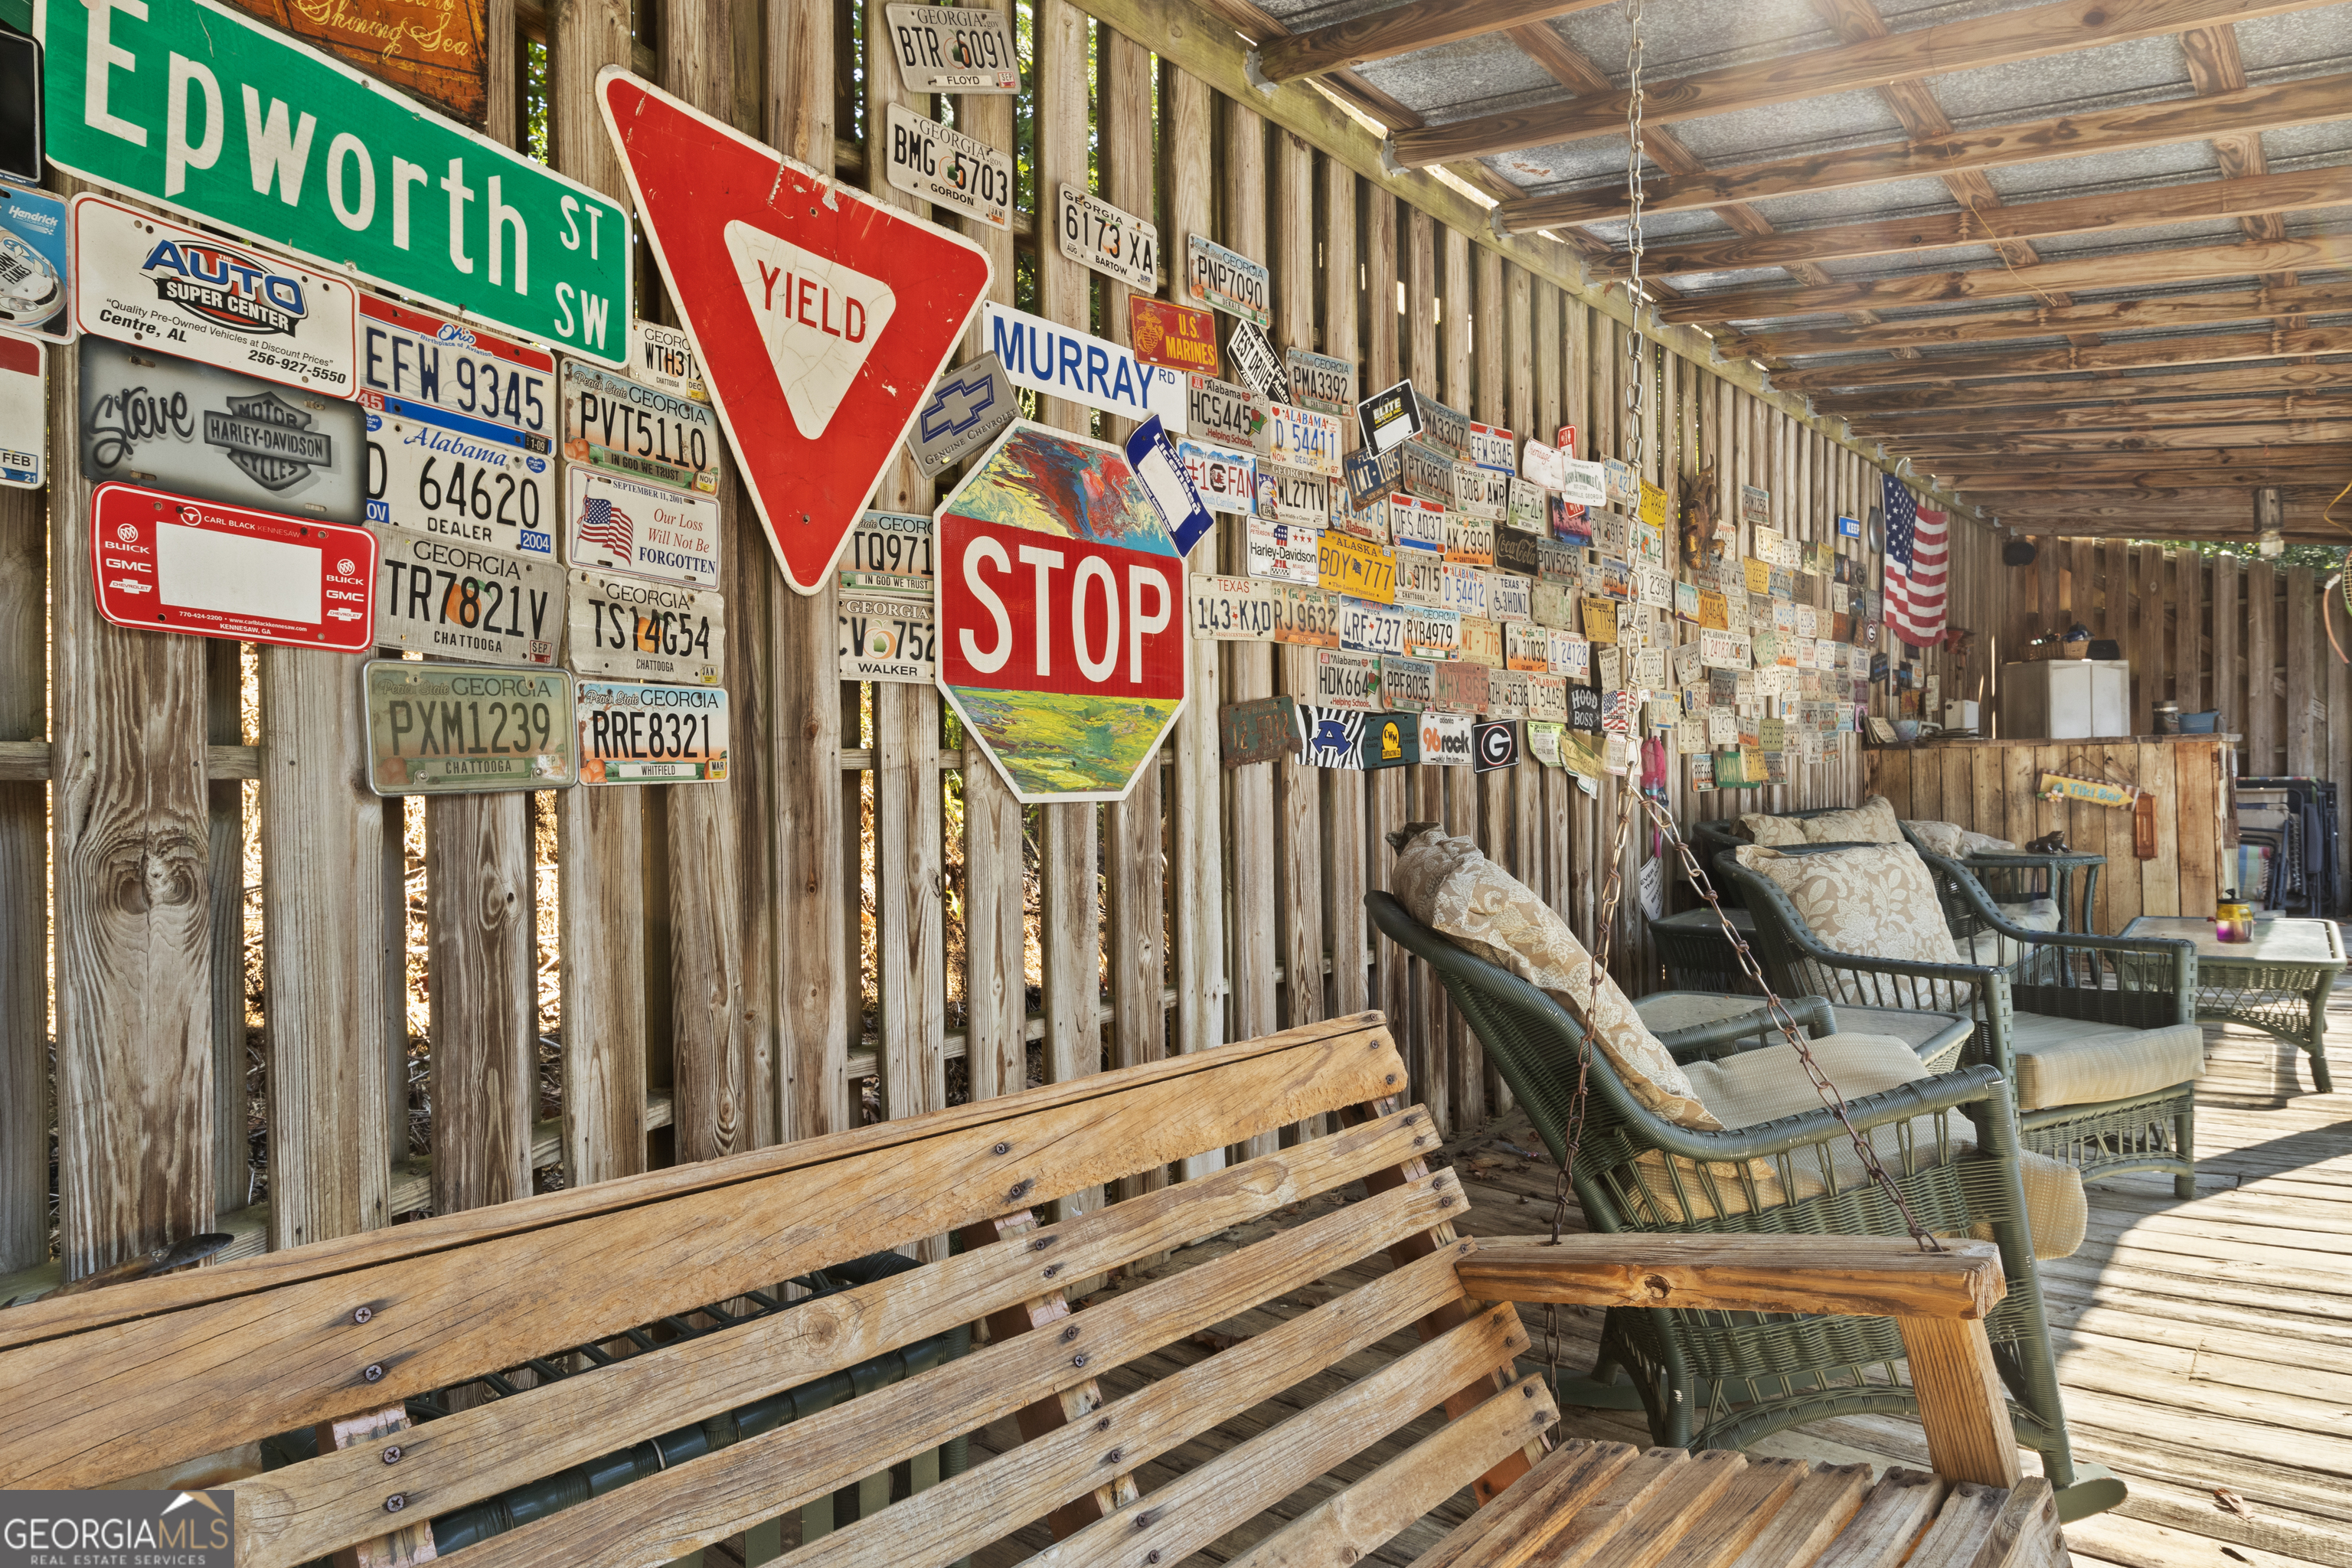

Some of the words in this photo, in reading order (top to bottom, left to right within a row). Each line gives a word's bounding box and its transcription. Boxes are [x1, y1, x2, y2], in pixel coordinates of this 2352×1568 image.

[291, 0, 403, 60] Shining
[401, 12, 469, 57] Sea
[897, 26, 943, 67] BTR
[956, 30, 1009, 68] 6091
[947, 77, 980, 86] FLOYD
[84, 0, 528, 296] Epworth
[894, 124, 936, 177] BMG
[955, 152, 1008, 207] 5703
[930, 183, 974, 206] GORDON
[8, 205, 59, 226] Hendrick
[1063, 191, 1123, 225] GEORGIA
[560, 195, 603, 260] ST
[1066, 204, 1120, 259] 6173
[1129, 232, 1153, 275] XA
[2, 264, 32, 285] FLAKES
[142, 240, 305, 315] AUTO
[1095, 255, 1128, 276] BARTOW
[1223, 253, 1264, 281] GEORGIA
[1197, 256, 1263, 310] PNP7090
[166, 281, 223, 308] SUPER
[227, 296, 289, 332] CENTER
[757, 259, 866, 344] YIELD
[100, 309, 160, 338] Centre,
[167, 328, 187, 342] AL
[554, 282, 609, 350] SW
[1178, 313, 1200, 338] U.S.
[151, 310, 207, 333] Pre-Owned
[210, 326, 247, 344] Vehicles
[261, 341, 300, 359] Discount
[436, 324, 476, 345] Ohio
[993, 315, 1155, 410] MURRAY
[1158, 368, 1175, 385] RD
[1165, 335, 1215, 366] MARINES
[1233, 323, 1255, 363] TEST
[1248, 350, 1272, 394] DRIVE
[1256, 336, 1276, 366] South
[1274, 365, 1288, 385] End
[247, 349, 346, 384] 256-927-5550
[366, 326, 440, 403] EFW
[457, 358, 544, 431] 9345
[1314, 358, 1349, 375] GEORGIA
[1206, 380, 1241, 400] Alabama
[1272, 380, 1289, 402] Auto
[1294, 366, 1348, 403] PMA3392
[238, 399, 298, 427] MOTOR
[629, 385, 707, 426] GEORGIA
[1191, 389, 1251, 436] HCS445
[1310, 400, 1333, 412] CHATTOOGA
[1373, 397, 1401, 420] ELITE
[1434, 405, 1467, 426] GEORGIA
[580, 391, 707, 472] PVT5110
[1284, 408, 1328, 430] ALABAMA
[211, 418, 323, 459] HARLEY-DAVIDSON
[403, 426, 508, 468] Alabama
[924, 438, 965, 466] GENUINE
[967, 407, 1017, 442] CHEVROLET
[1207, 428, 1230, 444] Helping
[1231, 433, 1253, 448] Schools
[1293, 423, 1334, 461] 54411
[2, 452, 31, 467] FEB
[1491, 440, 1513, 467] 9345
[1528, 443, 1552, 466] Heritage
[612, 453, 619, 467] IN
[622, 456, 639, 472] GOD
[641, 460, 653, 475] WE
[655, 463, 679, 482] TRUST
[1153, 432, 1201, 516] Licensed
[1272, 464, 1312, 481] GEORGIA
[1408, 456, 1452, 495] PTK8501
[419, 456, 540, 529] 64620
[613, 480, 657, 498] SEPTEMBER
[1228, 463, 1256, 500] FAN
[1277, 476, 1325, 512] WL27TV
[1457, 475, 1479, 501] 1308
[204, 515, 227, 525] CARL
[229, 520, 256, 530] BLACK
[257, 525, 301, 538] KENNESAW
[427, 517, 492, 543] DEALER
[653, 508, 675, 526] Our
[678, 514, 704, 533] Loss
[1345, 520, 1373, 537] Alabama
[1394, 508, 1414, 535] DFS
[1417, 513, 1442, 541] 4037
[1847, 521, 1860, 535] KEEP
[104, 541, 150, 554] BUICK
[522, 533, 550, 552] 2004
[648, 527, 671, 546] Will
[673, 531, 693, 550] Not
[695, 536, 710, 554] Be
[1250, 541, 1317, 564] Harley-Davidson
[1336, 537, 1378, 557] ALASKA
[1448, 528, 1459, 553] AK
[1463, 531, 1491, 555] 2990
[1496, 533, 1537, 567] Coca-Cola
[106, 558, 152, 573] GMC
[413, 540, 522, 581] GEORGIA
[639, 547, 717, 576] FORGOTTEN
[1319, 547, 1351, 579] BDY
[1364, 559, 1393, 593] 777
[1538, 550, 1578, 576] PQV5253
[326, 574, 364, 586] BUICK
[1217, 579, 1250, 593] TEXAS
[1414, 565, 1440, 592] 9715
[1451, 567, 1478, 581] ALABAMA
[1501, 578, 1520, 590] TEXAS
[326, 590, 364, 602] GMC
[384, 559, 548, 641] TR7821V
[606, 583, 691, 610] GEORGIA
[1354, 586, 1375, 597] Frontier
[1456, 579, 1485, 607] 54412
[1502, 592, 1527, 615] 3HDNZ
[179, 610, 223, 622] 770-424-2200
[845, 600, 930, 619] GEORGIA
[959, 535, 1171, 684] STOP
[1198, 598, 1231, 630] 143
[1240, 600, 1272, 632] KXD
[1274, 599, 1293, 631] RJ
[1298, 603, 1338, 636] 9632
[1361, 600, 1383, 611] TEXAS
[1364, 608, 1381, 616] TRUCK
[1423, 609, 1457, 622] GEORGIA
[260, 627, 272, 635] GA
[588, 599, 710, 659] TS14G54
[1344, 611, 1369, 642] 4RF
[1375, 617, 1400, 647] Z37
[1406, 619, 1453, 648] RYB4979
[1465, 619, 1491, 629] FLORIDA
[434, 631, 502, 654] CHATTOOGA
[1523, 639, 1547, 663] 31032
[1562, 642, 1587, 666] 24128
[636, 658, 674, 672] CHATTOOGA
[858, 663, 918, 676] WALKER
[1332, 655, 1361, 667] Alabama
[1403, 662, 1431, 675] GEORGIA
[451, 678, 552, 697] GEORGIA
[1319, 665, 1369, 697] HDK664
[1387, 671, 1430, 702] PPF8035
[640, 688, 719, 709] GEORGIA
[1332, 697, 1351, 707] Helping
[1352, 698, 1370, 707] Schools
[1540, 685, 1565, 710] 54452
[1571, 688, 1598, 710] HOOD
[390, 700, 550, 756] PXM1239
[1574, 710, 1594, 727] BOSS
[593, 710, 710, 759] RRE8321
[1423, 727, 1441, 753] 96
[1441, 730, 1471, 754] rock
[445, 760, 512, 775] CHATTOOGA
[641, 764, 676, 776] WHITFIELD
[2069, 782, 2095, 798] Tiki
[2098, 787, 2122, 802] Bar
